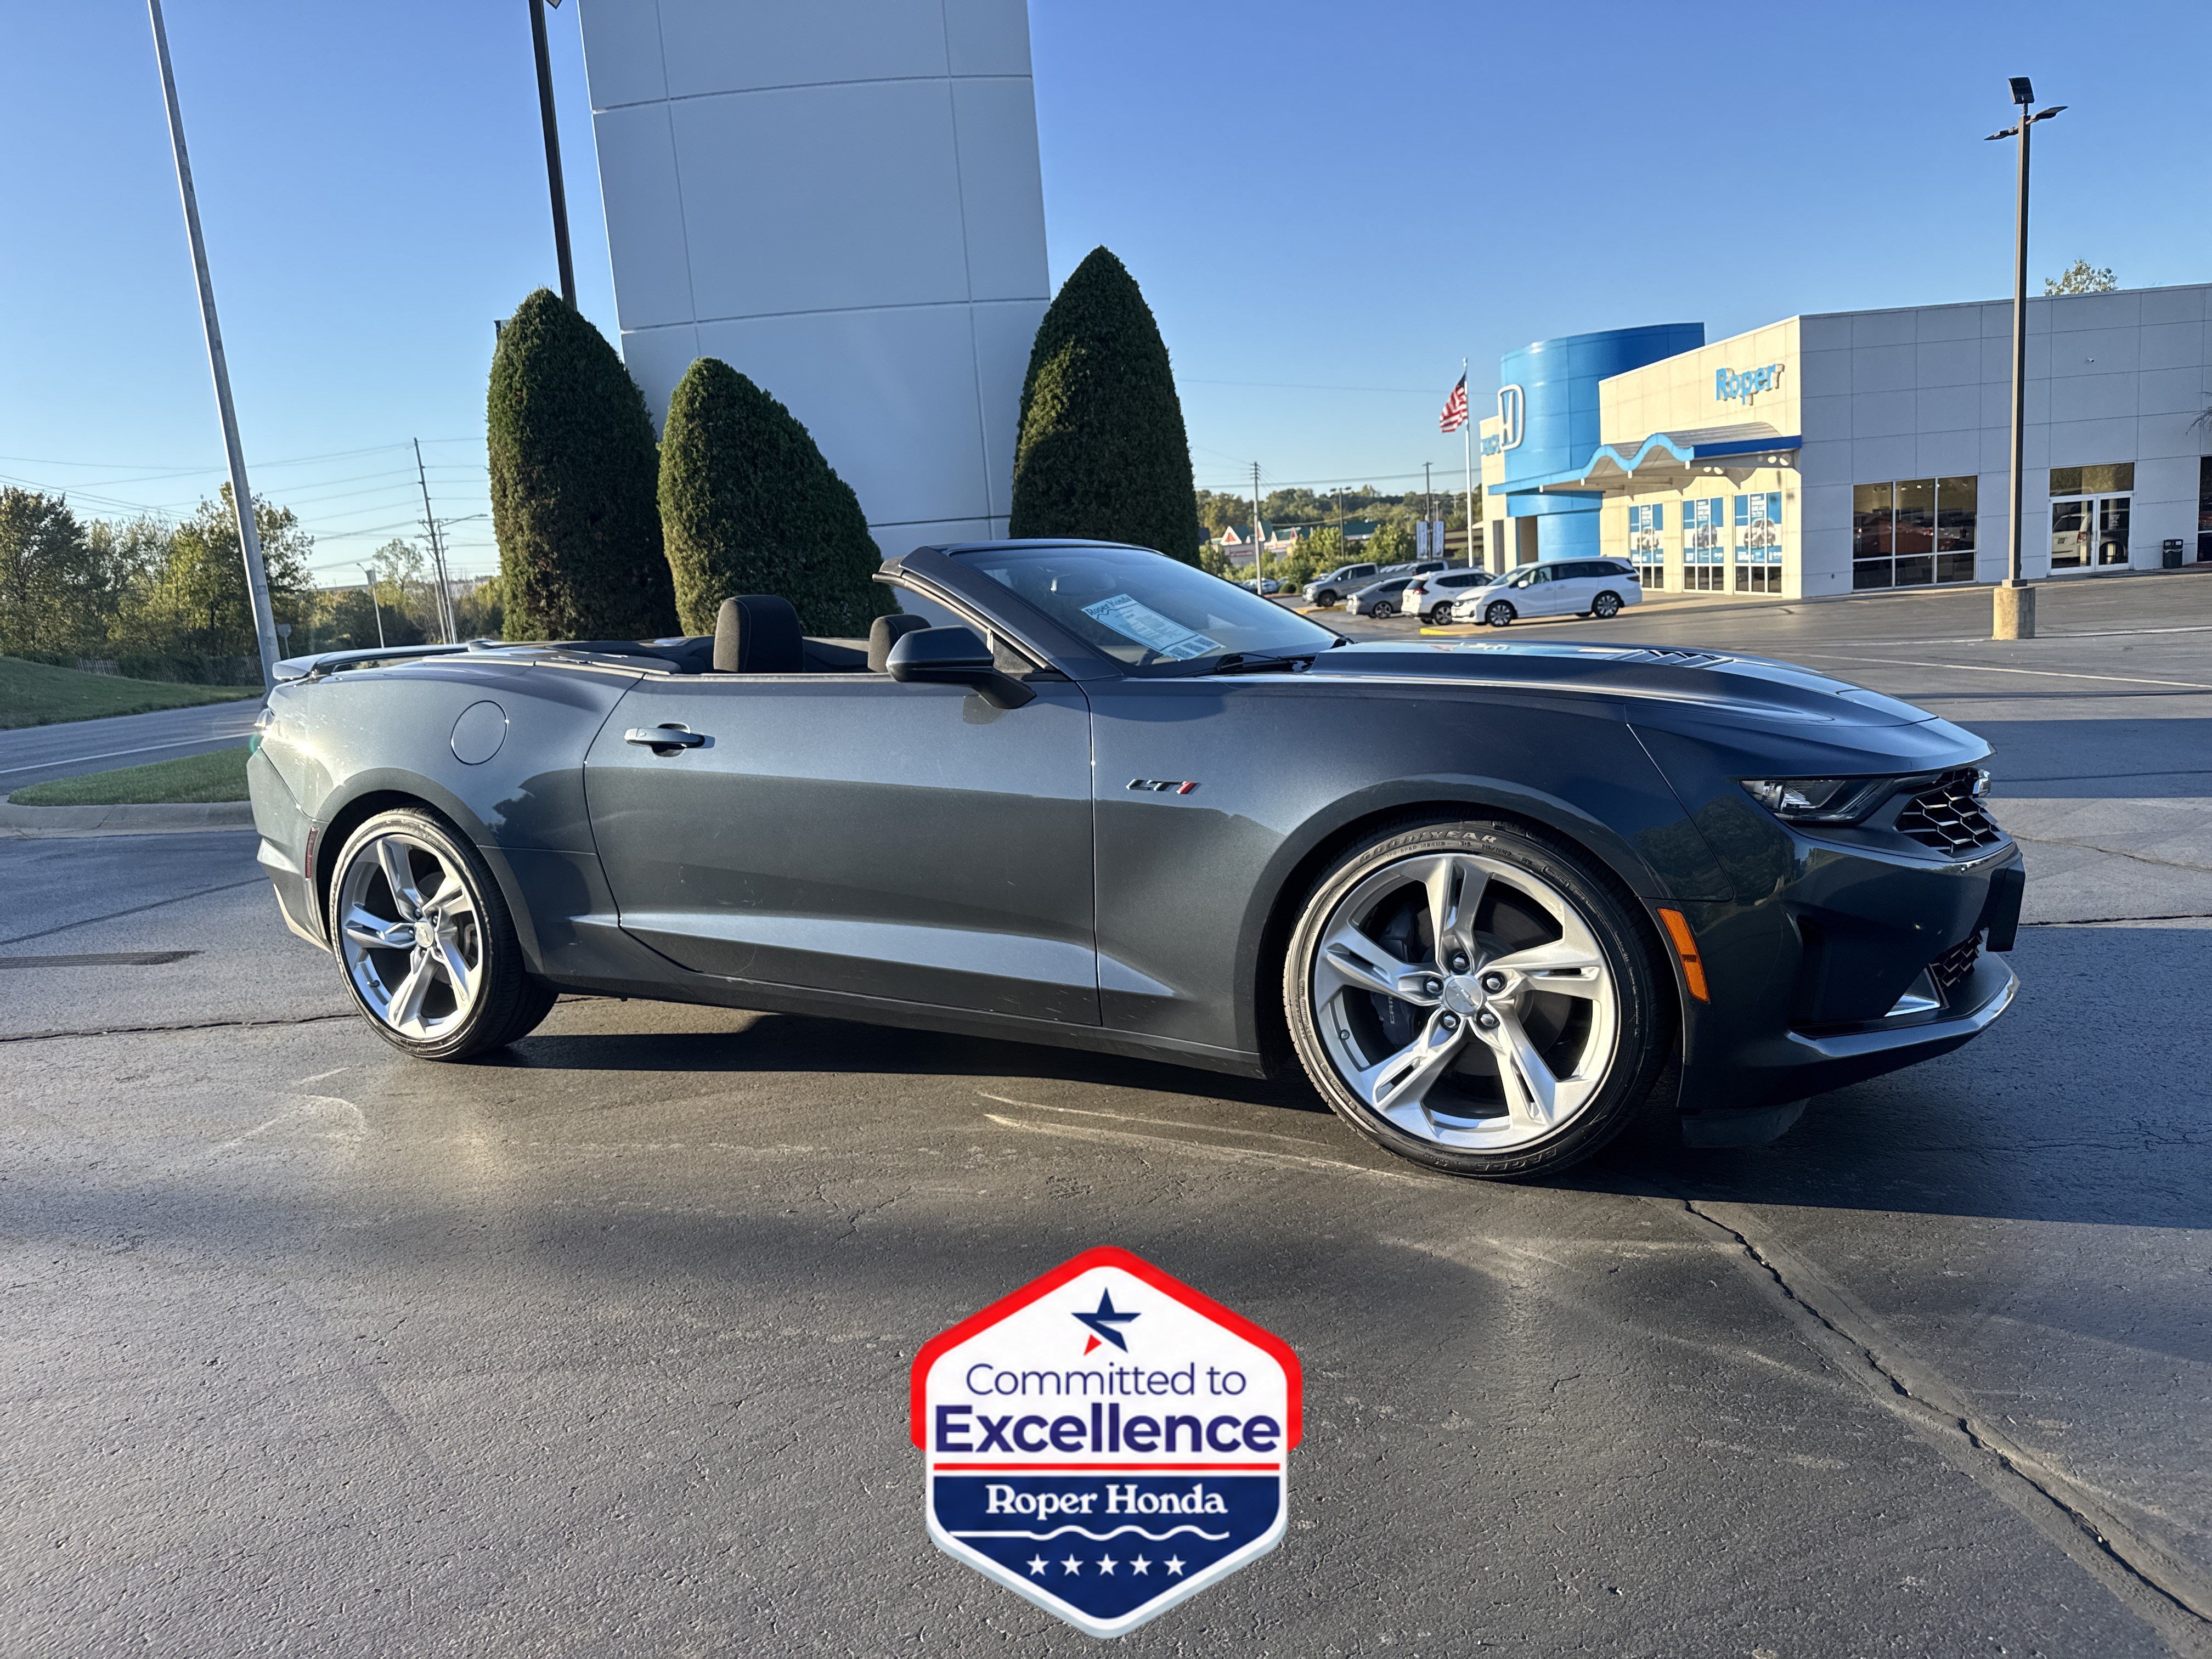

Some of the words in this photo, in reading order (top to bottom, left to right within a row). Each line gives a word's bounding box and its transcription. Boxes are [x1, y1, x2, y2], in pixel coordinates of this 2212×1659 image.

[1716, 364, 1783, 405] Roper
[1085, 604, 1110, 616] Roper
[1126, 778, 1197, 795] LT1
